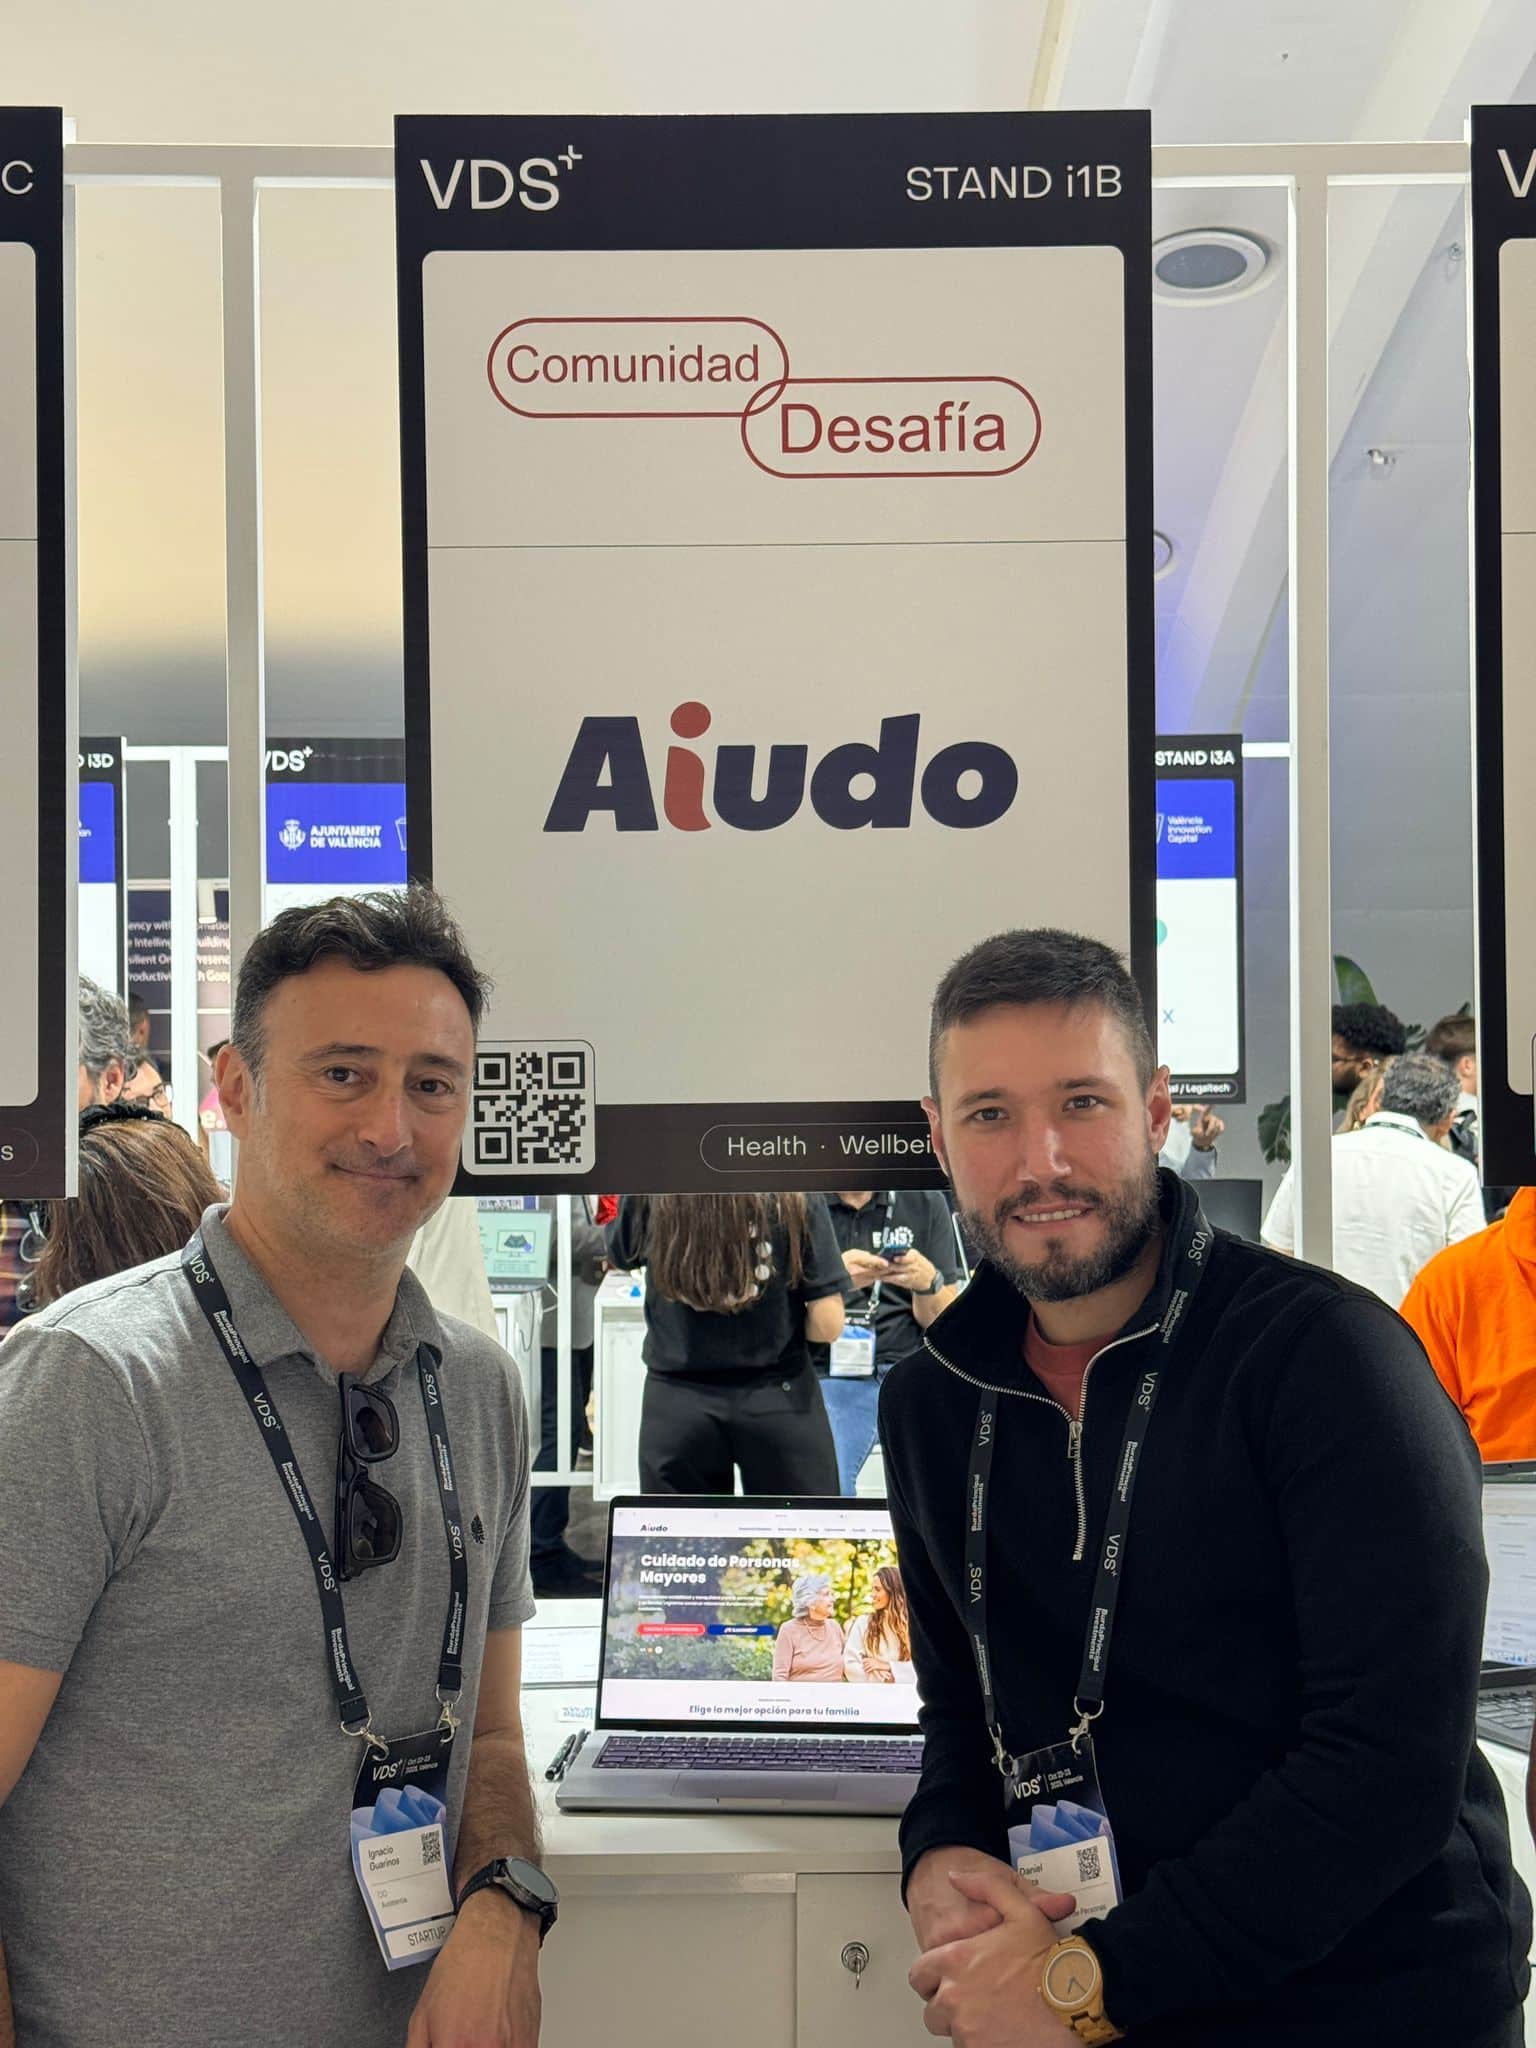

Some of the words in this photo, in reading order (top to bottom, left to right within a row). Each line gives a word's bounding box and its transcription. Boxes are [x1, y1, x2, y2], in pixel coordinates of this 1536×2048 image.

[906, 166, 1052, 201] STAND
[1066, 164, 1123, 198] i1B
[507, 343, 760, 384] Comunidad
[780, 400, 1007, 455] Desafía
[1155, 750, 1208, 766] STAND
[543, 701, 1018, 832] Aiudo
[310, 825, 382, 837] AJUNTAMENT
[310, 837, 325, 848] DE
[728, 1136, 807, 1156] Health
[839, 1134, 936, 1155] Wellbei
[640, 1524, 668, 1532] Aiudo
[641, 1553, 705, 1567] Cuidado
[708, 1554, 727, 1567] de
[729, 1555, 800, 1569] Personas
[640, 1571, 706, 1586] Mayores
[689, 1704, 712, 1716] Elige
[714, 1705, 723, 1714] la
[724, 1705, 752, 1717] mejor
[754, 1704, 786, 1717] opción
[789, 1709, 812, 1717] para
[814, 1707, 823, 1716] tu
[825, 1706, 860, 1717] familia
[368, 1845, 394, 1860] Ignacio
[369, 1858, 400, 1871] Guarinos
[1019, 1863, 1043, 1876] Daniel
[408, 1926, 446, 1946] STARTUP
